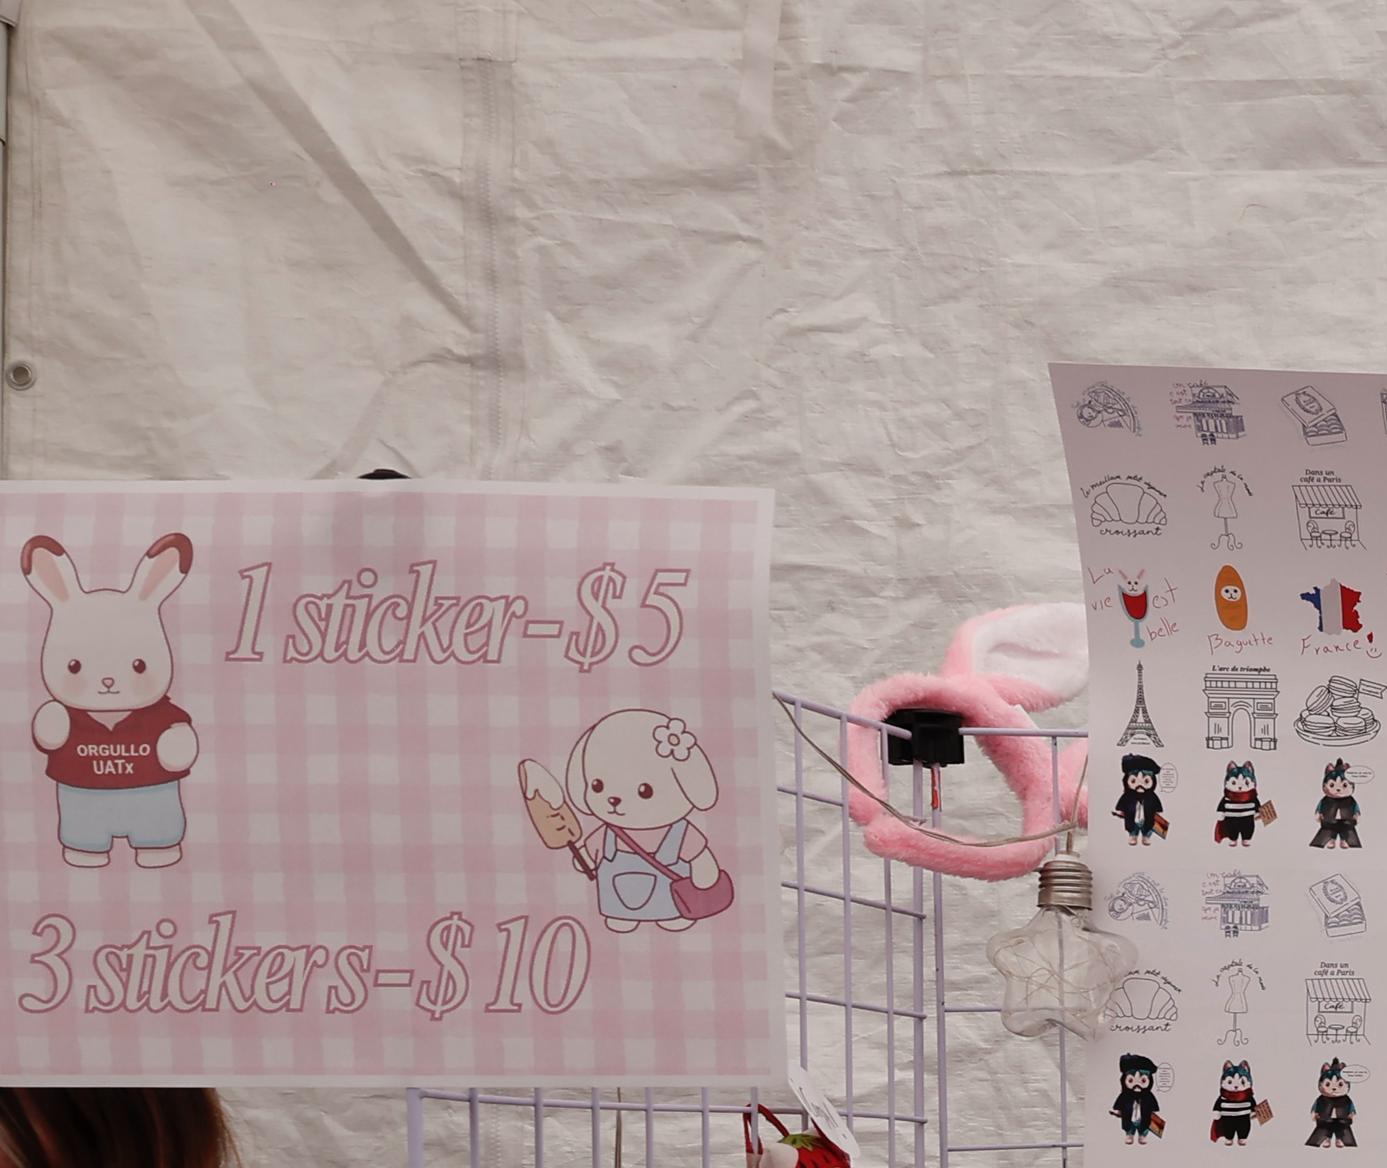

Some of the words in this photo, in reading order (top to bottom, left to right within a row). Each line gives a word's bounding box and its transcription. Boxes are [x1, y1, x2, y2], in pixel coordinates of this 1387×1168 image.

[1305, 468, 1324, 476] Dans
[1100, 526, 1162, 538] croissant
[1088, 567, 1114, 585] La
[1091, 597, 1113, 611] vie
[1152, 577, 1178, 609] est
[226, 562, 272, 662] 1
[1146, 616, 1180, 643] belle
[1208, 632, 1274, 655] Baguette
[77, 743, 151, 757] ORGULLO
[93, 759, 134, 775] UATx
[18, 913, 77, 1014] 3
[1320, 961, 1338, 969] Dans
